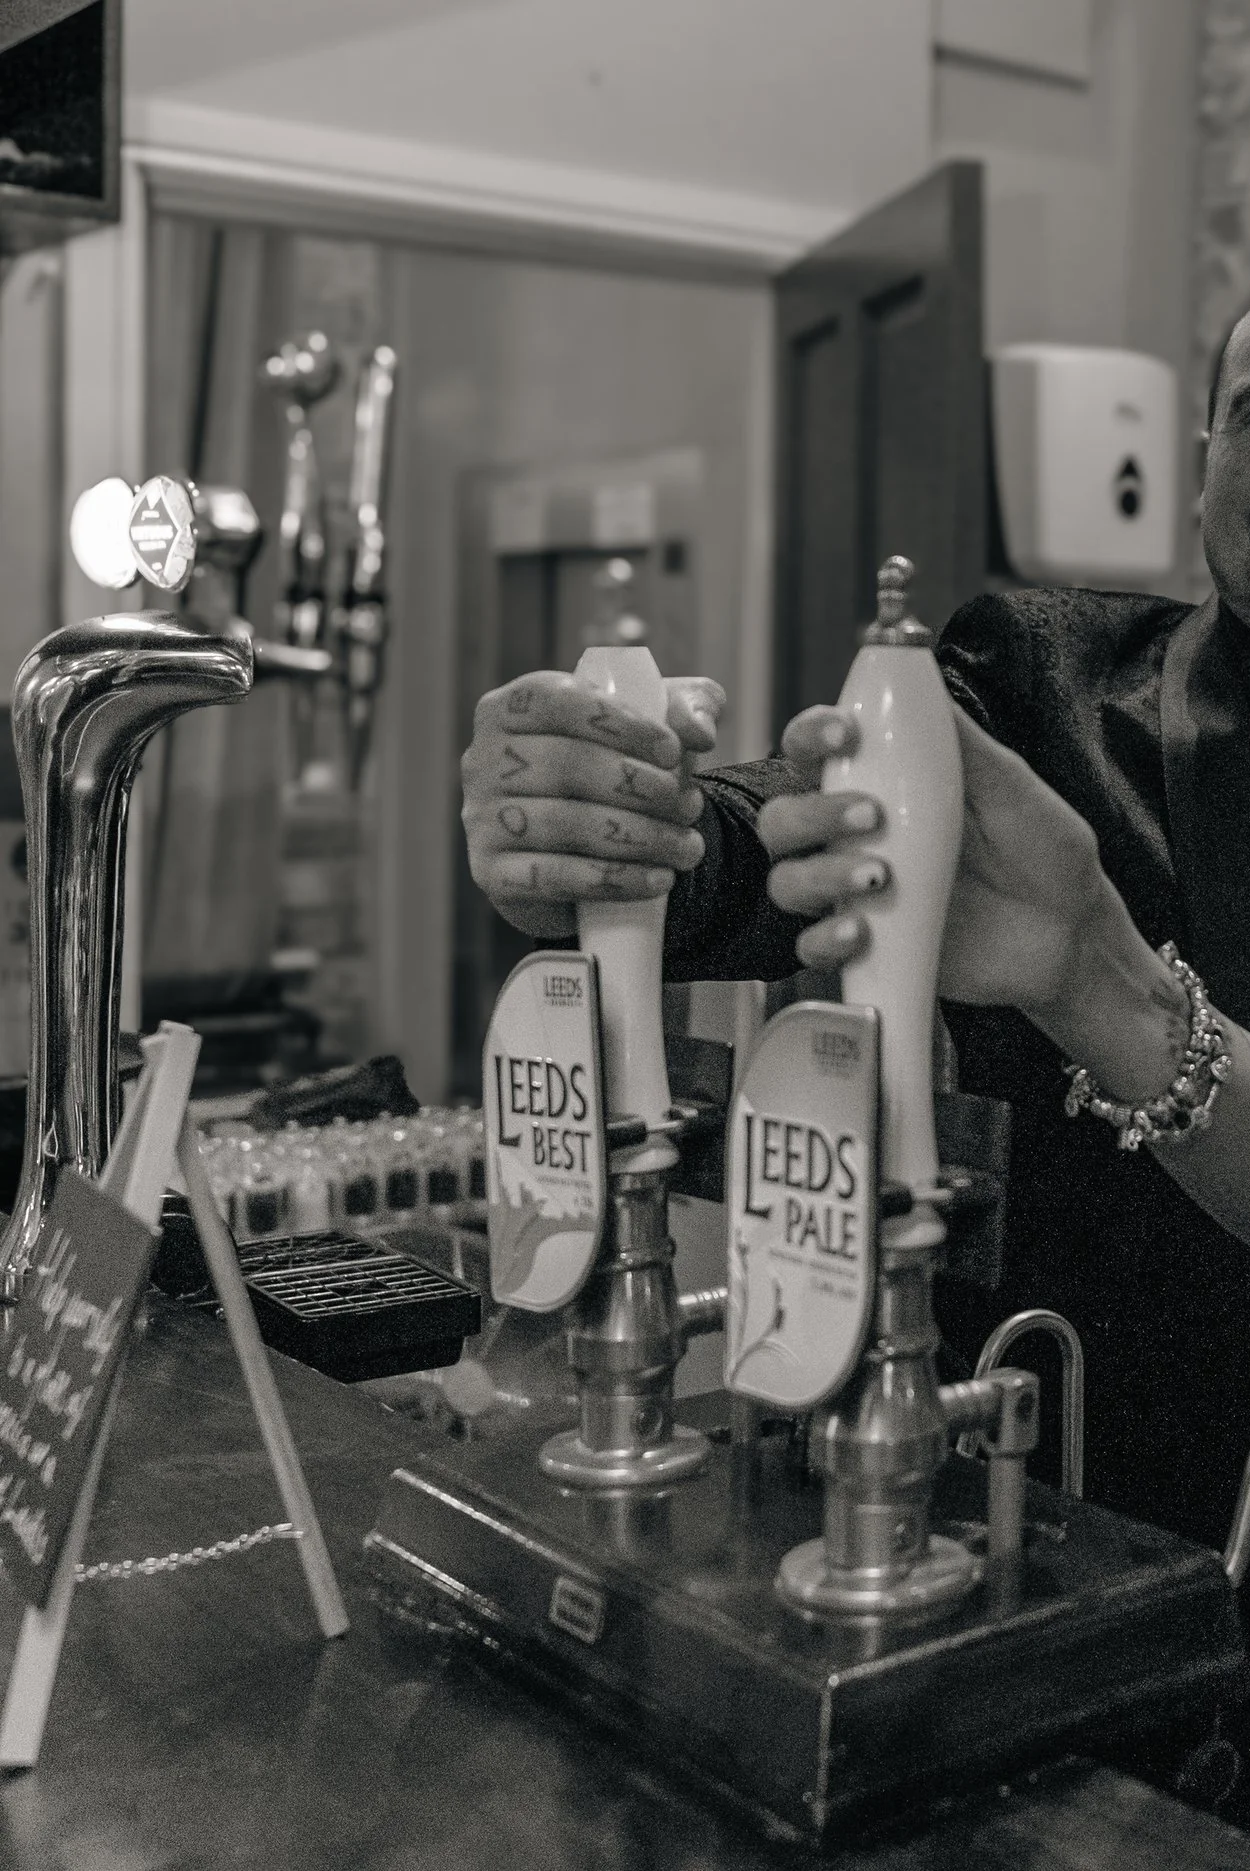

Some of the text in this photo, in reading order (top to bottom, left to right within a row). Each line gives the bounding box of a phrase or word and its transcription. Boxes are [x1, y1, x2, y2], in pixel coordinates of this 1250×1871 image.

[543, 975, 583, 998] LEEDS
[495, 1055, 587, 1147] LEEDS
[533, 1125, 592, 1172] BEST
[745, 1115, 857, 1219] LEEDS
[785, 1199, 857, 1260] PALE
